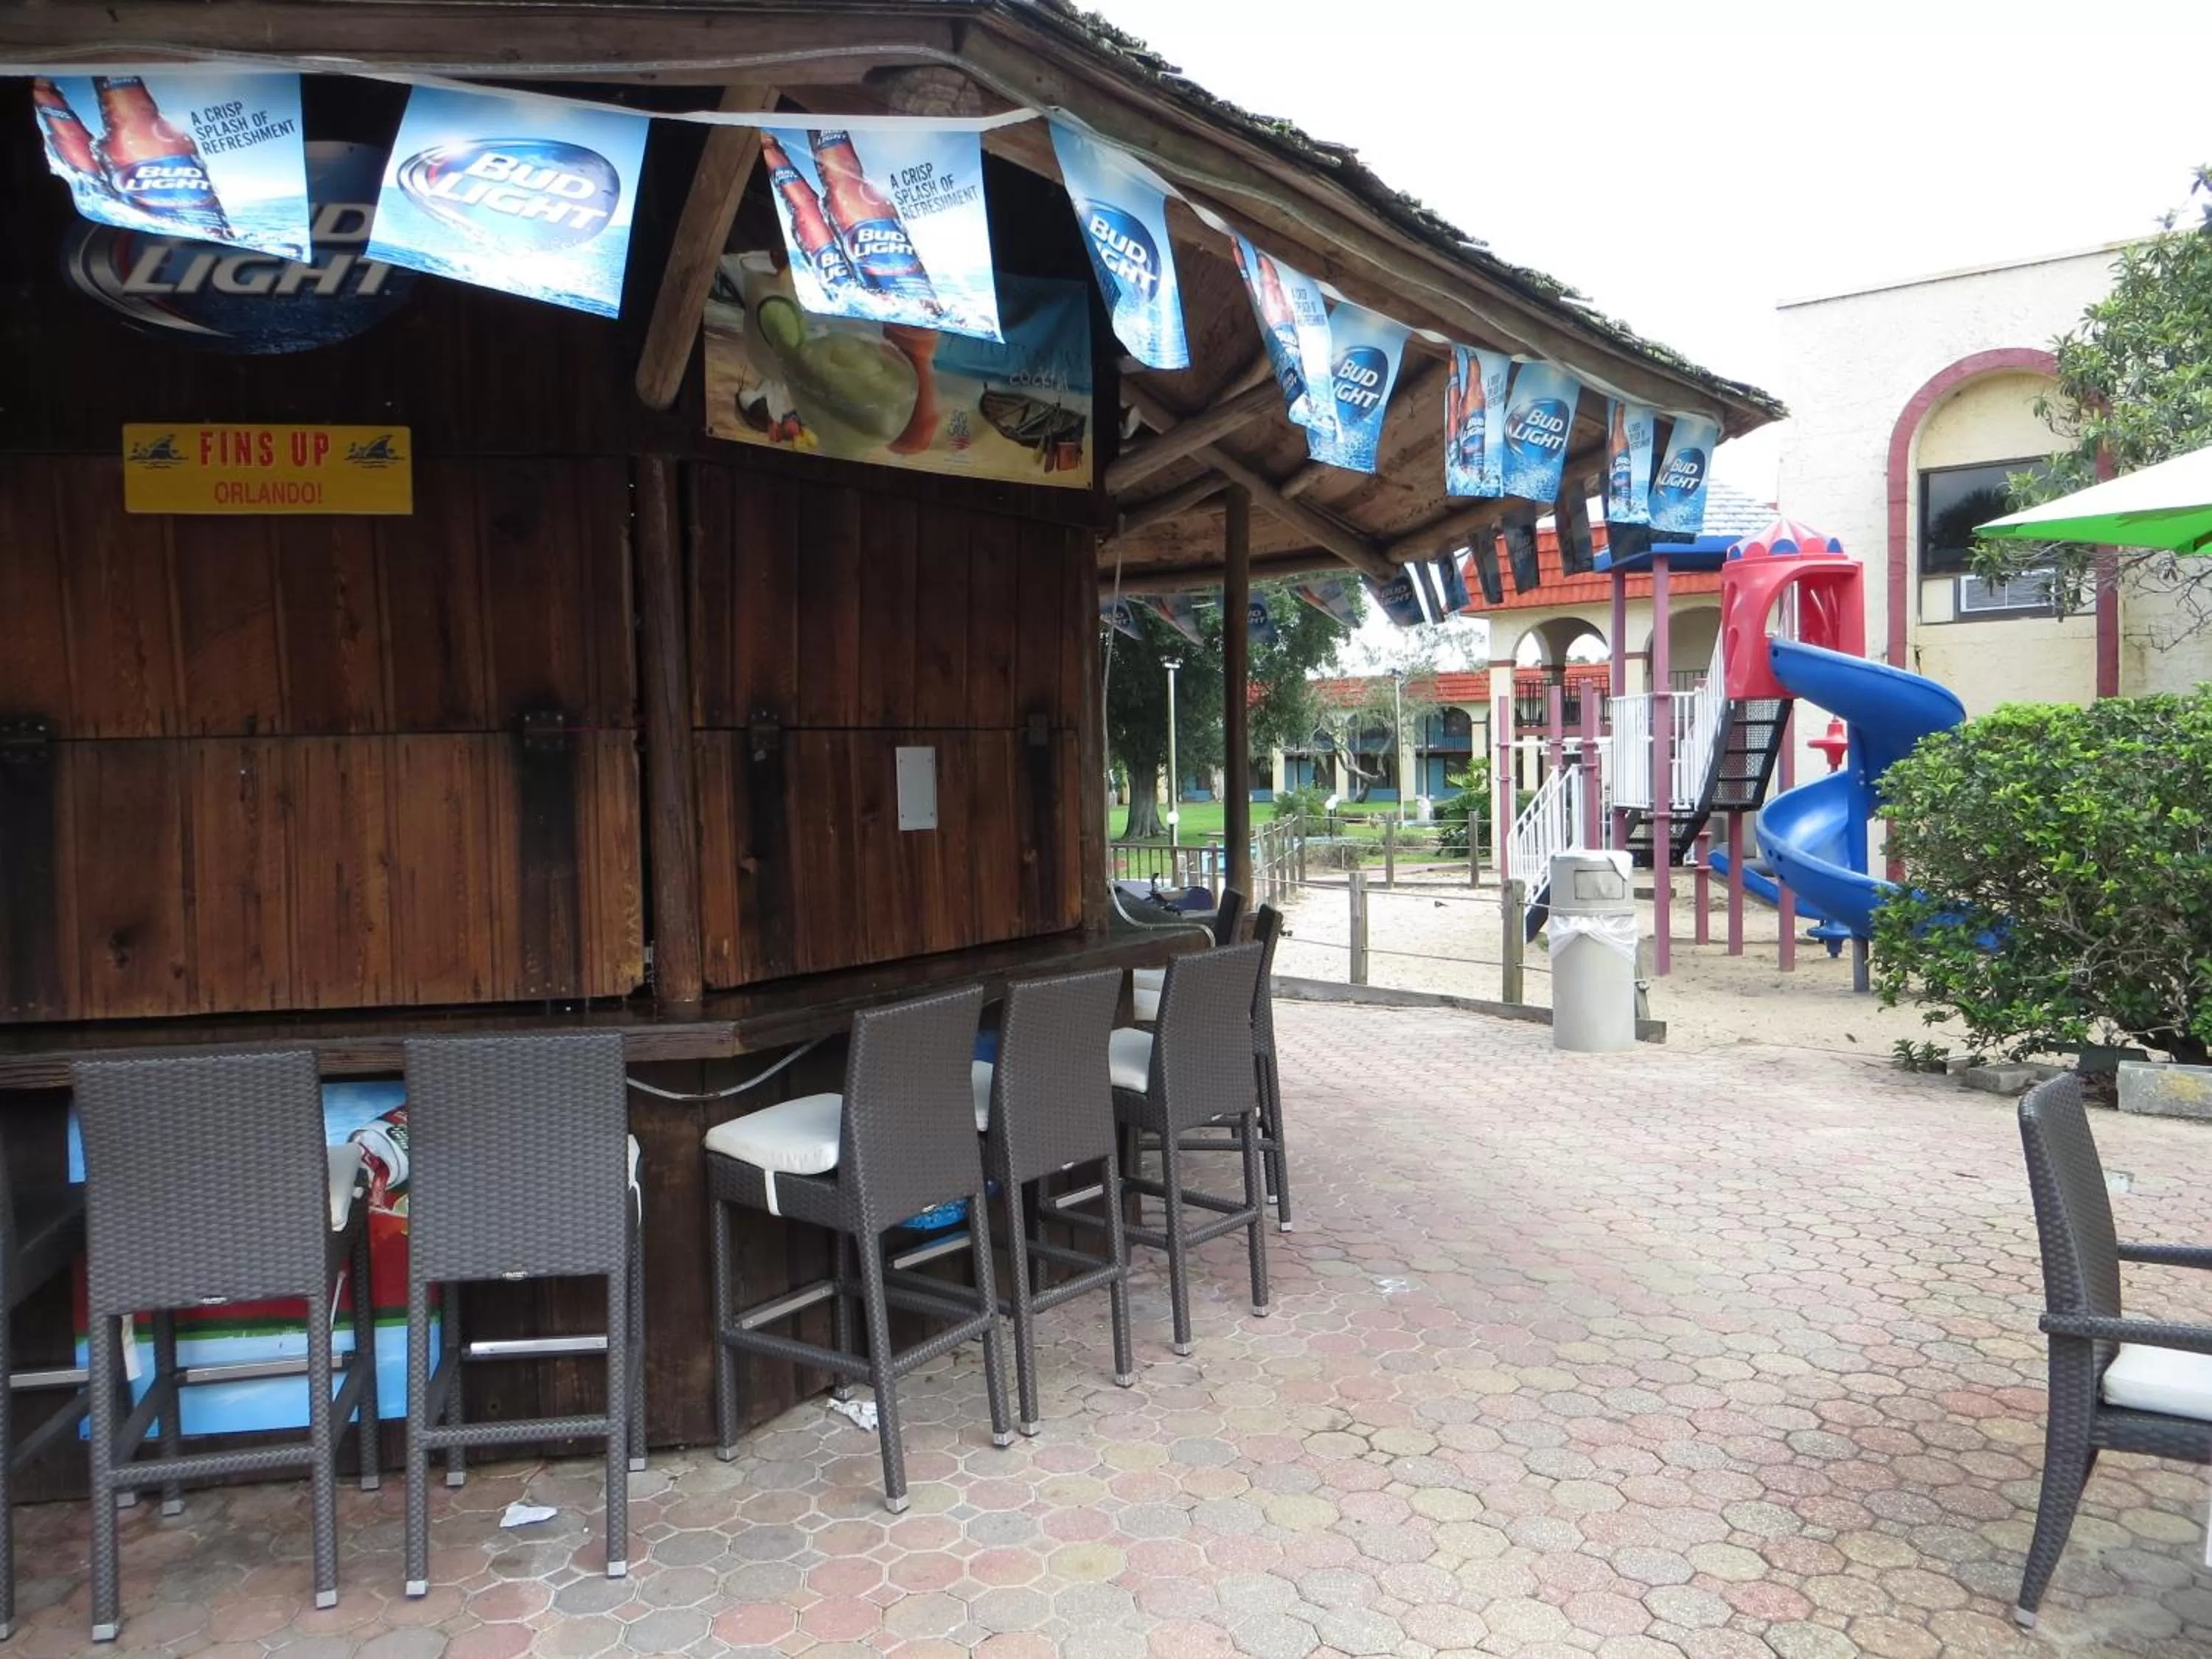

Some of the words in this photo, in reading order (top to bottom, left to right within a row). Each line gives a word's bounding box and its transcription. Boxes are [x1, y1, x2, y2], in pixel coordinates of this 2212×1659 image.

[190, 111, 201, 126] A
[204, 101, 243, 122] CRISP
[196, 116, 248, 142] SPLASH
[252, 111, 269, 128] OF
[200, 119, 296, 156] REFRESHMENT
[125, 178, 212, 191] LIGHT
[135, 165, 203, 179] BUD
[464, 152, 597, 201] BUD
[889, 173, 900, 189] A
[901, 163, 933, 187] CRISP
[428, 171, 608, 229] LIGHT
[894, 182, 938, 206] SPLASH
[940, 173, 956, 189] OF
[900, 185, 979, 220] REFRESHMENT
[857, 227, 907, 243] BUD
[1088, 214, 1147, 263] BUD
[854, 243, 915, 257] LIGHT
[1338, 359, 1378, 387] BUD
[1526, 409, 1564, 432] BUD
[199, 431, 275, 468] FINS
[291, 431, 330, 467] UP
[1510, 423, 1564, 450] LIGHT
[1670, 459, 1698, 475] BUD
[214, 481, 323, 505] ORLANDO!
[1660, 473, 1700, 490] LIGHT
